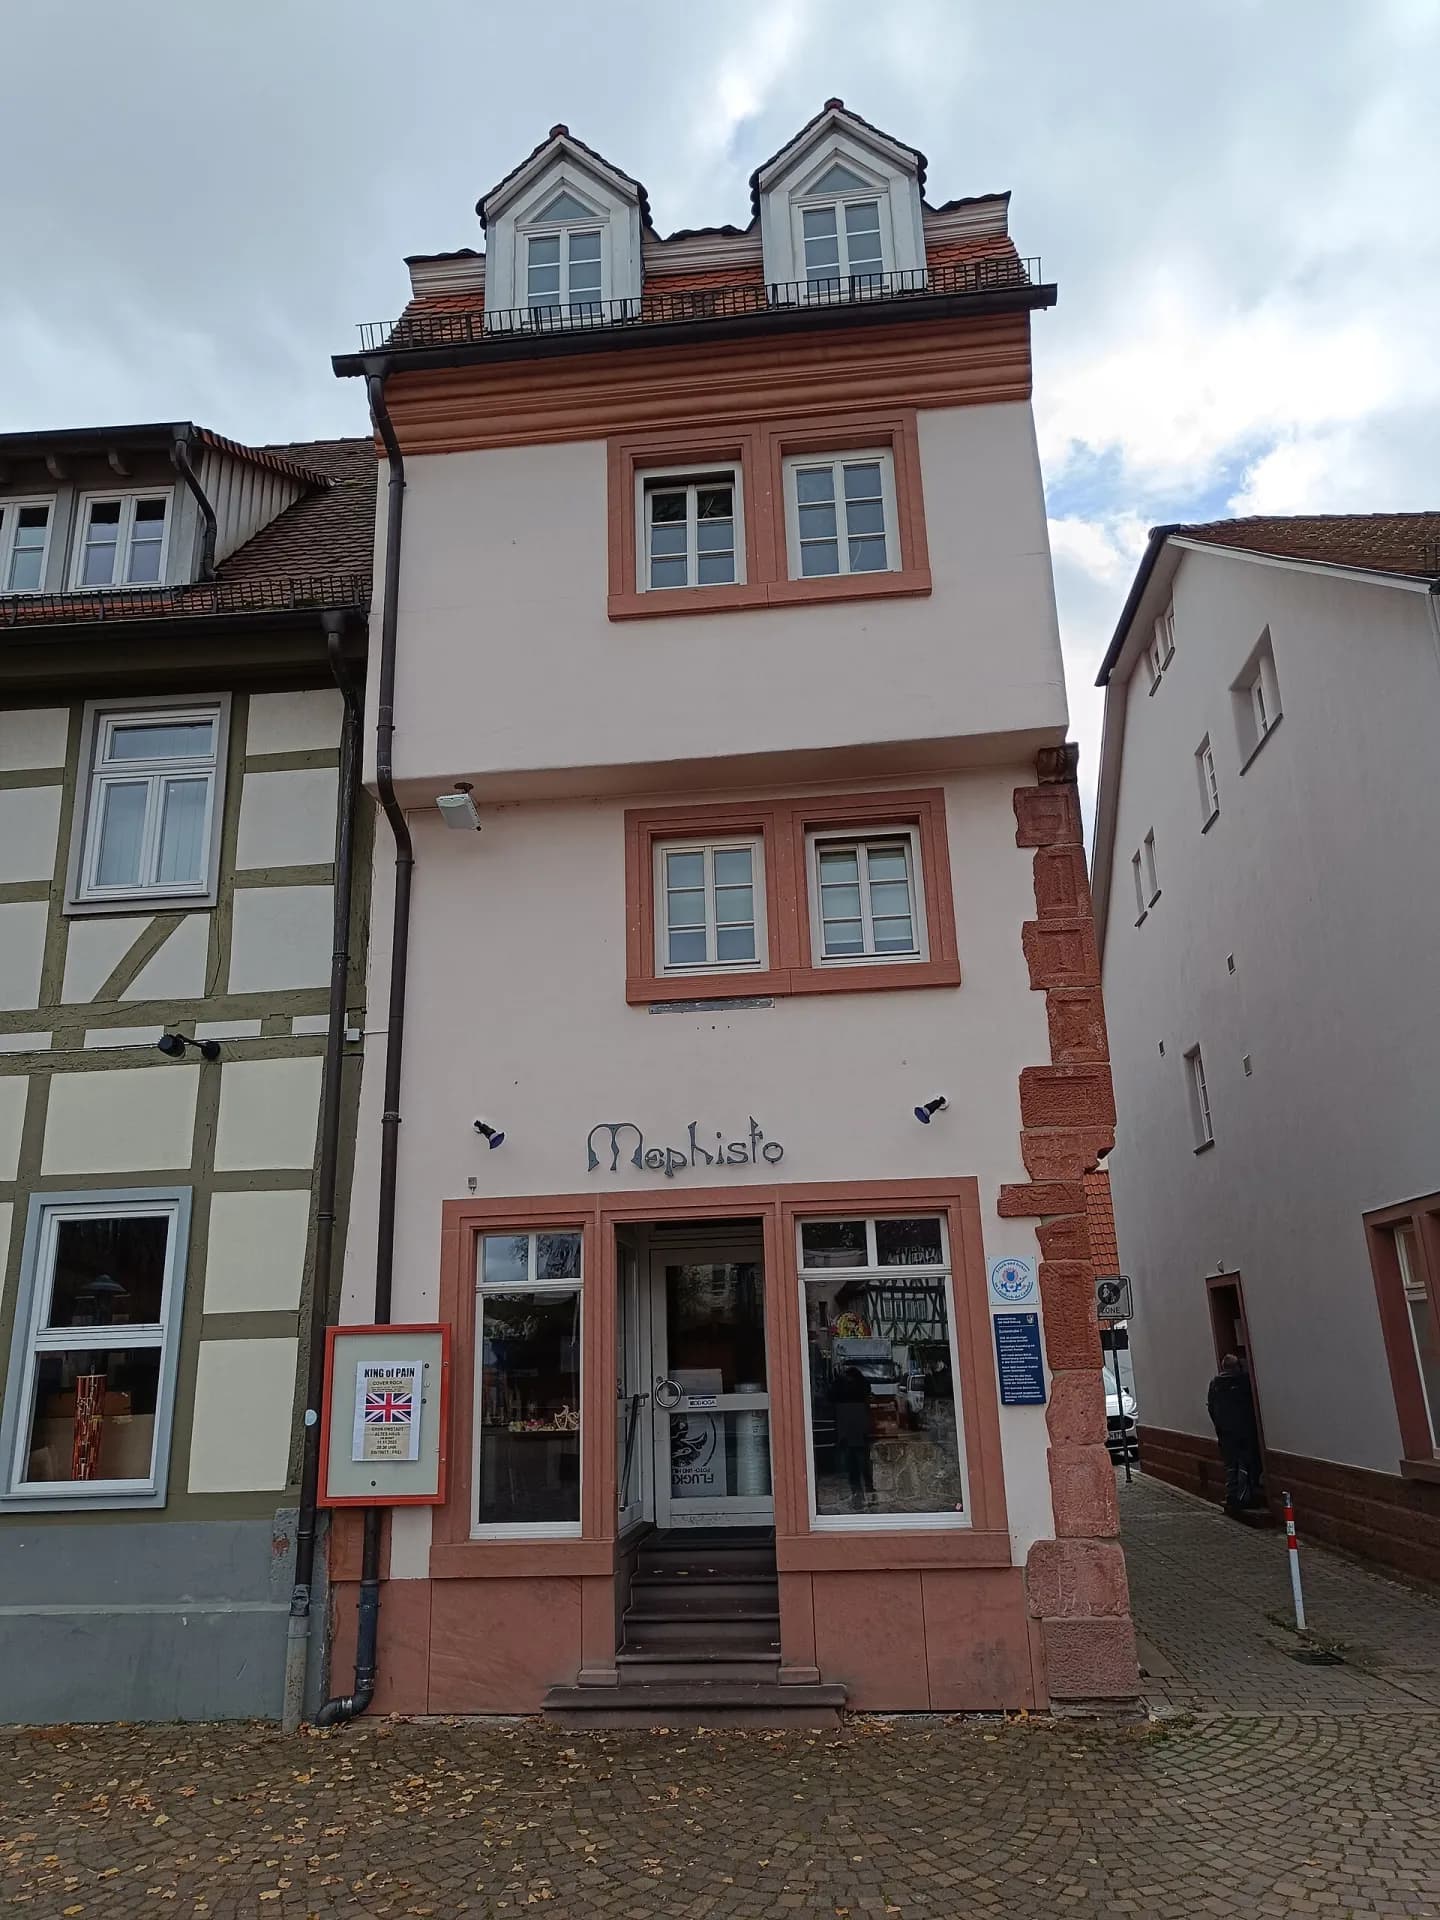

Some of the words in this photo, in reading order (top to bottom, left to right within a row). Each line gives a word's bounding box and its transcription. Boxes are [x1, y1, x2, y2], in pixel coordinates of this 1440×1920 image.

[587, 1115, 784, 1177] Mephisto
[1102, 1306, 1121, 1314] ZONE
[364, 1368, 384, 1378] KING
[385, 1368, 394, 1378] of
[395, 1367, 415, 1378] PAIN
